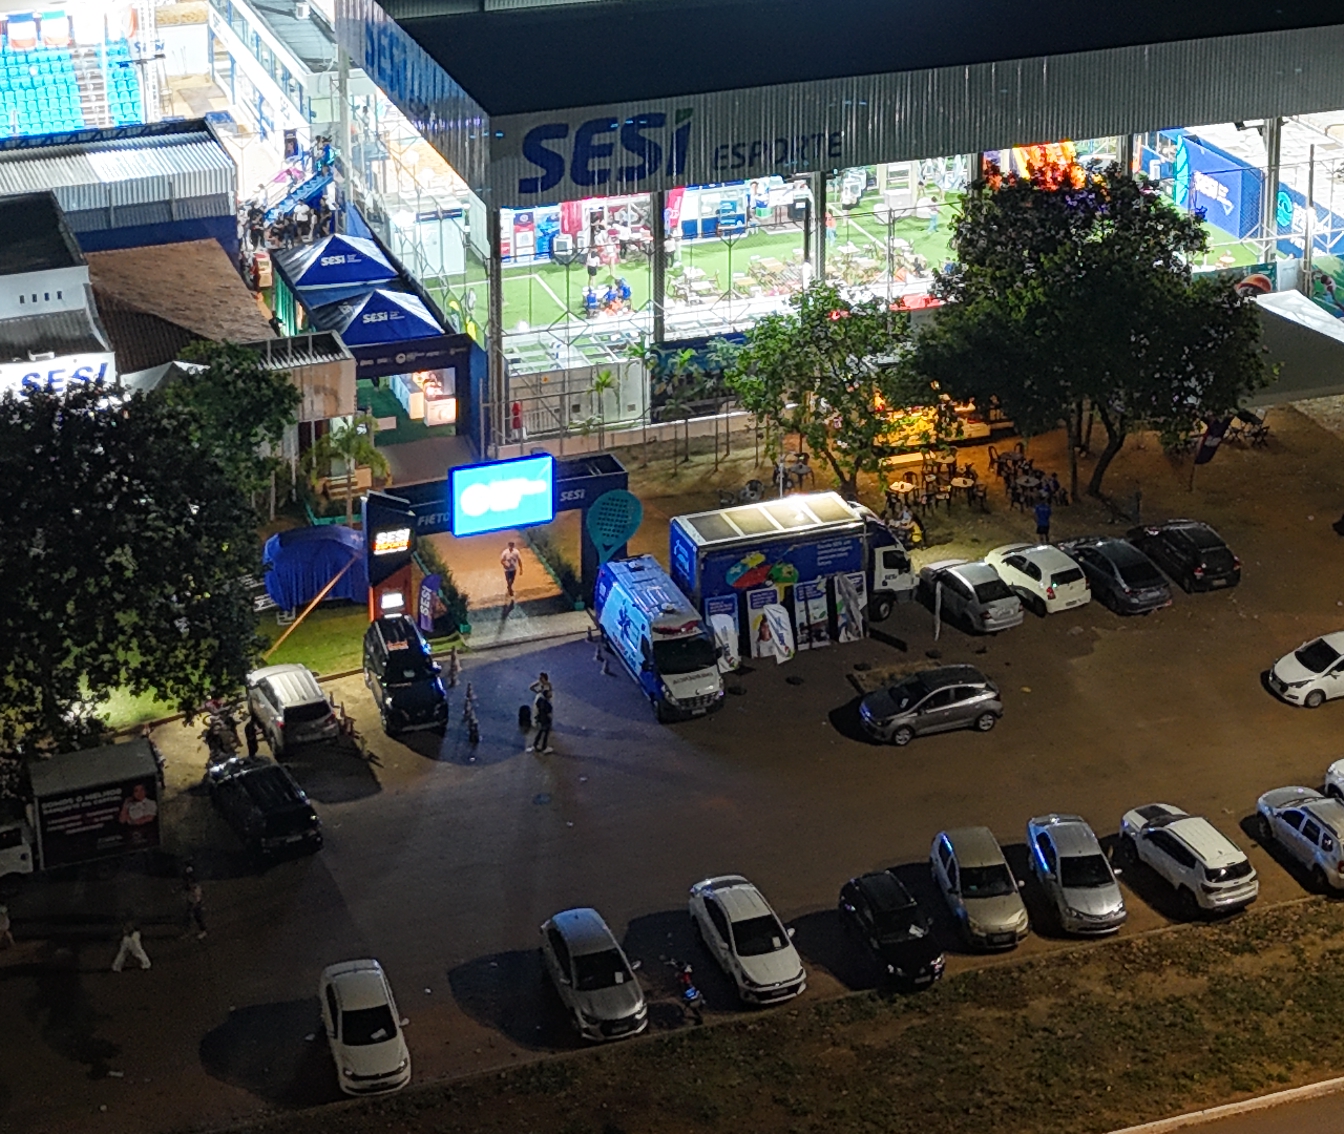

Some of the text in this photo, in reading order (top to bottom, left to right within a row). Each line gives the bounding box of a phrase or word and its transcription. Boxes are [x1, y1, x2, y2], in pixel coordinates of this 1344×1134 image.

[518, 107, 844, 194] SESI ESPORTE
[320, 254, 346, 267] SESI
[362, 312, 388, 324] SESI
[559, 489, 586, 502] SESI
[376, 529, 410, 545] SESI
[420, 585, 433, 617] SESI
